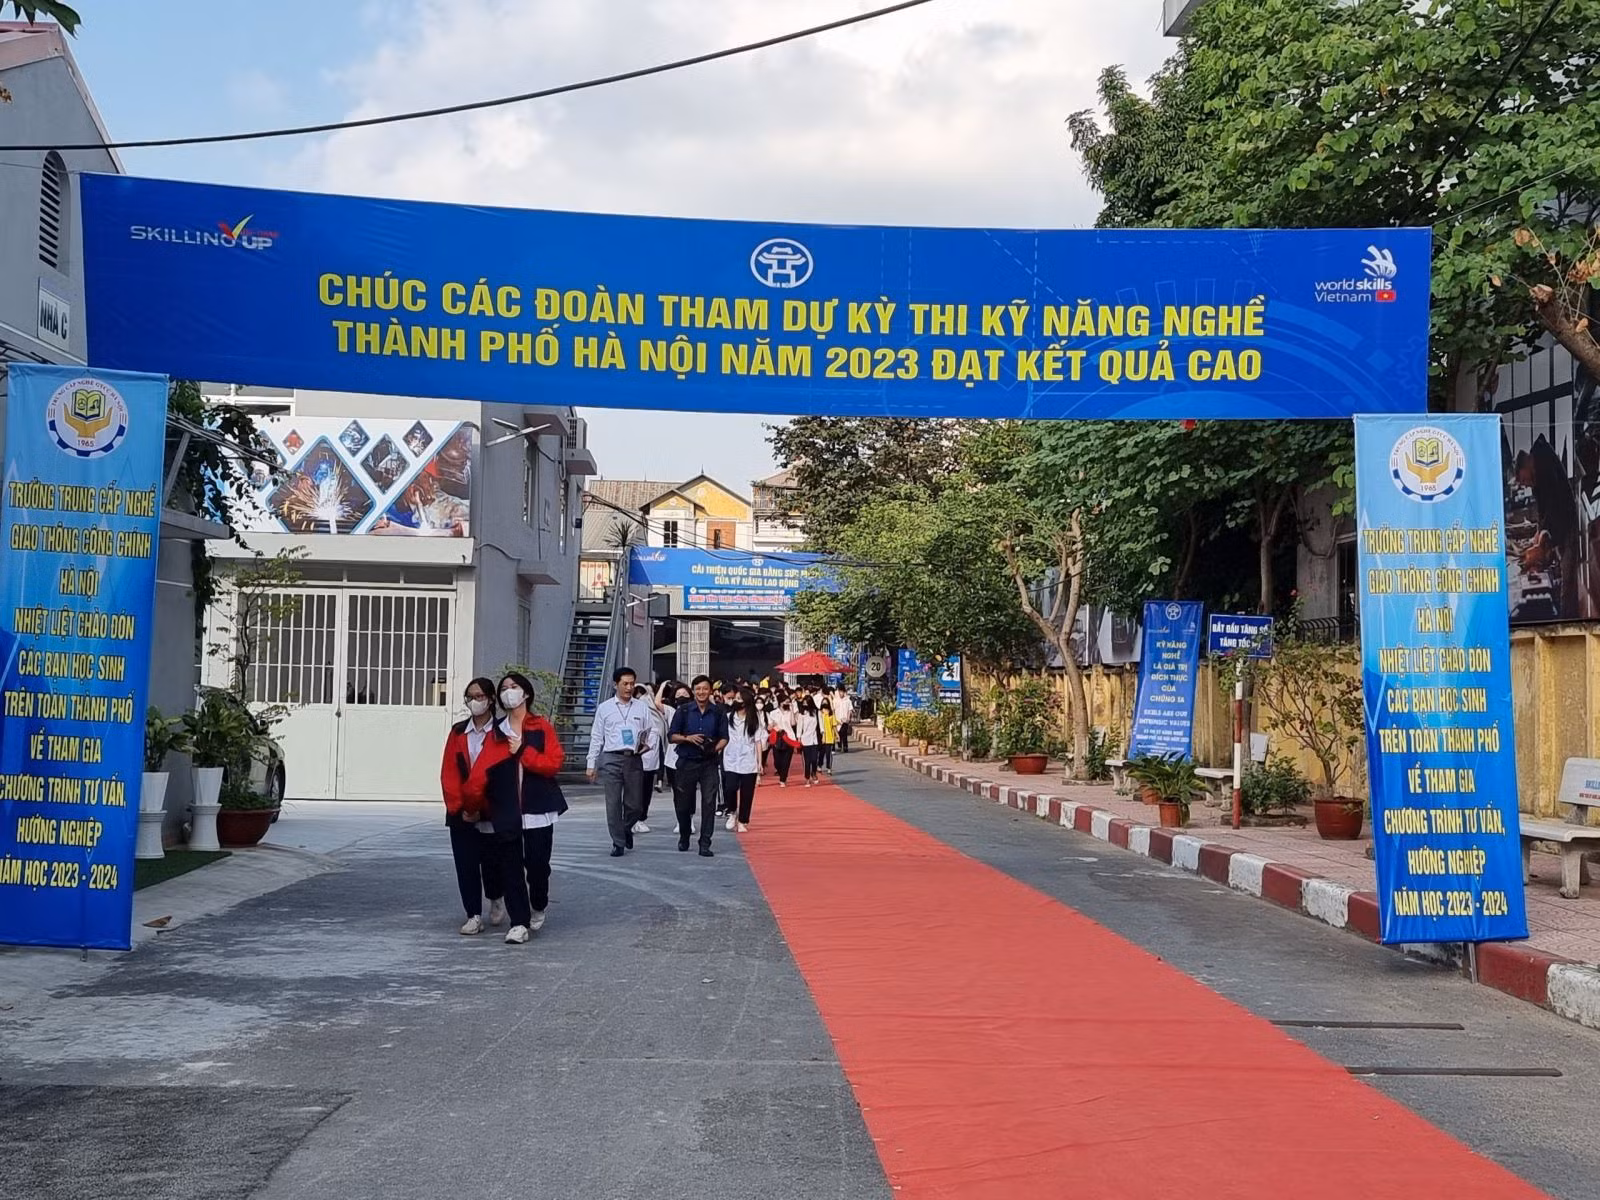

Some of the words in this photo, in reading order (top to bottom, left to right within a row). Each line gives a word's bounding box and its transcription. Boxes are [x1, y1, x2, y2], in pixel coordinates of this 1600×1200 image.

[242, 235, 273, 250] UP
[319, 271, 427, 312] CHÚC
[442, 278, 521, 318] CÁC
[535, 284, 645, 325] ĐOÀN
[658, 295, 769, 331] THAM
[783, 298, 839, 340] DỰ
[848, 296, 897, 334] KỲ
[909, 304, 968, 336] THI
[982, 299, 1030, 337] KỸ
[1043, 298, 1150, 337] NĂNG
[1164, 294, 1265, 337] NGHỀ
[1314, 291, 1372, 303] Vietnam
[40, 299, 59, 336] NHÀ
[61, 311, 68, 340] C
[332, 317, 466, 361] THÀNH
[480, 323, 560, 366] PHỐ
[574, 331, 626, 370] HÀ
[640, 334, 706, 380] NỘI
[721, 337, 811, 377] NĂM
[825, 347, 919, 379] 2023
[931, 349, 1005, 388] ĐẠT
[1017, 339, 1086, 381] KẾT
[1099, 339, 1175, 385] QUẢ
[1188, 350, 1262, 381] CAO
[78, 440, 95, 448] 1965
[9, 477, 55, 511] TRƯỜNG
[58, 484, 95, 513] TRUNG
[98, 480, 121, 516] CẤP
[125, 482, 157, 518] NGHỀ
[11, 524, 38, 551] GIAO
[42, 523, 79, 554] THÔNG
[83, 524, 113, 557] CÔNG
[116, 527, 152, 559] CHÍNH
[1363, 522, 1404, 554] TRƯỜNG
[1407, 529, 1443, 554] TRUNG
[1445, 519, 1466, 554] CẤP
[1469, 521, 1498, 554] NGHỀ
[59, 564, 75, 595] HÀ
[77, 566, 99, 601] NỘI
[749, 567, 761, 576] GIA
[764, 578, 777, 587] LAO
[1368, 568, 1394, 593] GIAO
[1396, 564, 1432, 593] THÔNG
[1435, 564, 1462, 593] CÔNG
[1466, 563, 1499, 593] CHÍNH
[13, 604, 49, 640] NHIỆT
[50, 605, 75, 642] LIỆT
[77, 609, 107, 638] CHÀO
[110, 611, 135, 640] ĐÓN
[1417, 603, 1433, 633] HÀ
[1435, 604, 1454, 638] NỘI
[18, 645, 41, 675] CÁC
[44, 652, 69, 683] BẠN
[71, 653, 95, 684] HỌC
[98, 655, 125, 682] SINH
[871, 662, 881, 671] 20
[1380, 644, 1410, 678] NHIỆT
[1412, 643, 1437, 678] LIỆT
[1439, 645, 1465, 673] CHÀO
[1468, 644, 1491, 673] ĐÓN
[4, 687, 34, 718] TRÊN
[37, 688, 67, 719] TOÀN
[70, 691, 108, 722] THÀNH
[110, 689, 135, 724] PHỐ
[1387, 683, 1409, 713] CÁC
[1412, 687, 1435, 718] BẠN
[1439, 687, 1458, 719] HỌC
[1461, 688, 1487, 713] SINH
[30, 727, 45, 760] VỀ
[47, 735, 80, 763] THAM
[82, 737, 102, 764] GIA
[1378, 723, 1407, 753] TRÊN
[1409, 723, 1439, 753] TOÀN
[1441, 724, 1475, 753] THÀNH
[1477, 719, 1500, 753] PHỐ
[0, 773, 44, 802] CHƯƠNG
[48, 772, 81, 804] TRÌNH
[84, 778, 101, 805] TƯ
[102, 772, 127, 809] VẤN,
[1407, 761, 1422, 793] VỀ
[1424, 768, 1457, 794] THAM
[1458, 768, 1476, 793] GIA
[17, 813, 57, 844] HƯỚNG
[59, 816, 103, 853] NGHIỆP
[1383, 807, 1428, 835] CHƯƠNG
[1430, 804, 1464, 834] TRÌNH
[1465, 807, 1480, 834] TƯ
[1480, 800, 1506, 836] VẤN,
[24, 860, 48, 891] HỌC
[50, 861, 79, 888] 2023
[89, 863, 118, 890] 2024
[1407, 844, 1446, 875] HƯỚNG
[1448, 846, 1486, 880] NGHIỆP
[1394, 886, 1419, 917] NĂM
[1422, 890, 1444, 921] HỌC
[1447, 890, 1473, 916] 2023
[1482, 891, 1508, 917] 2024
